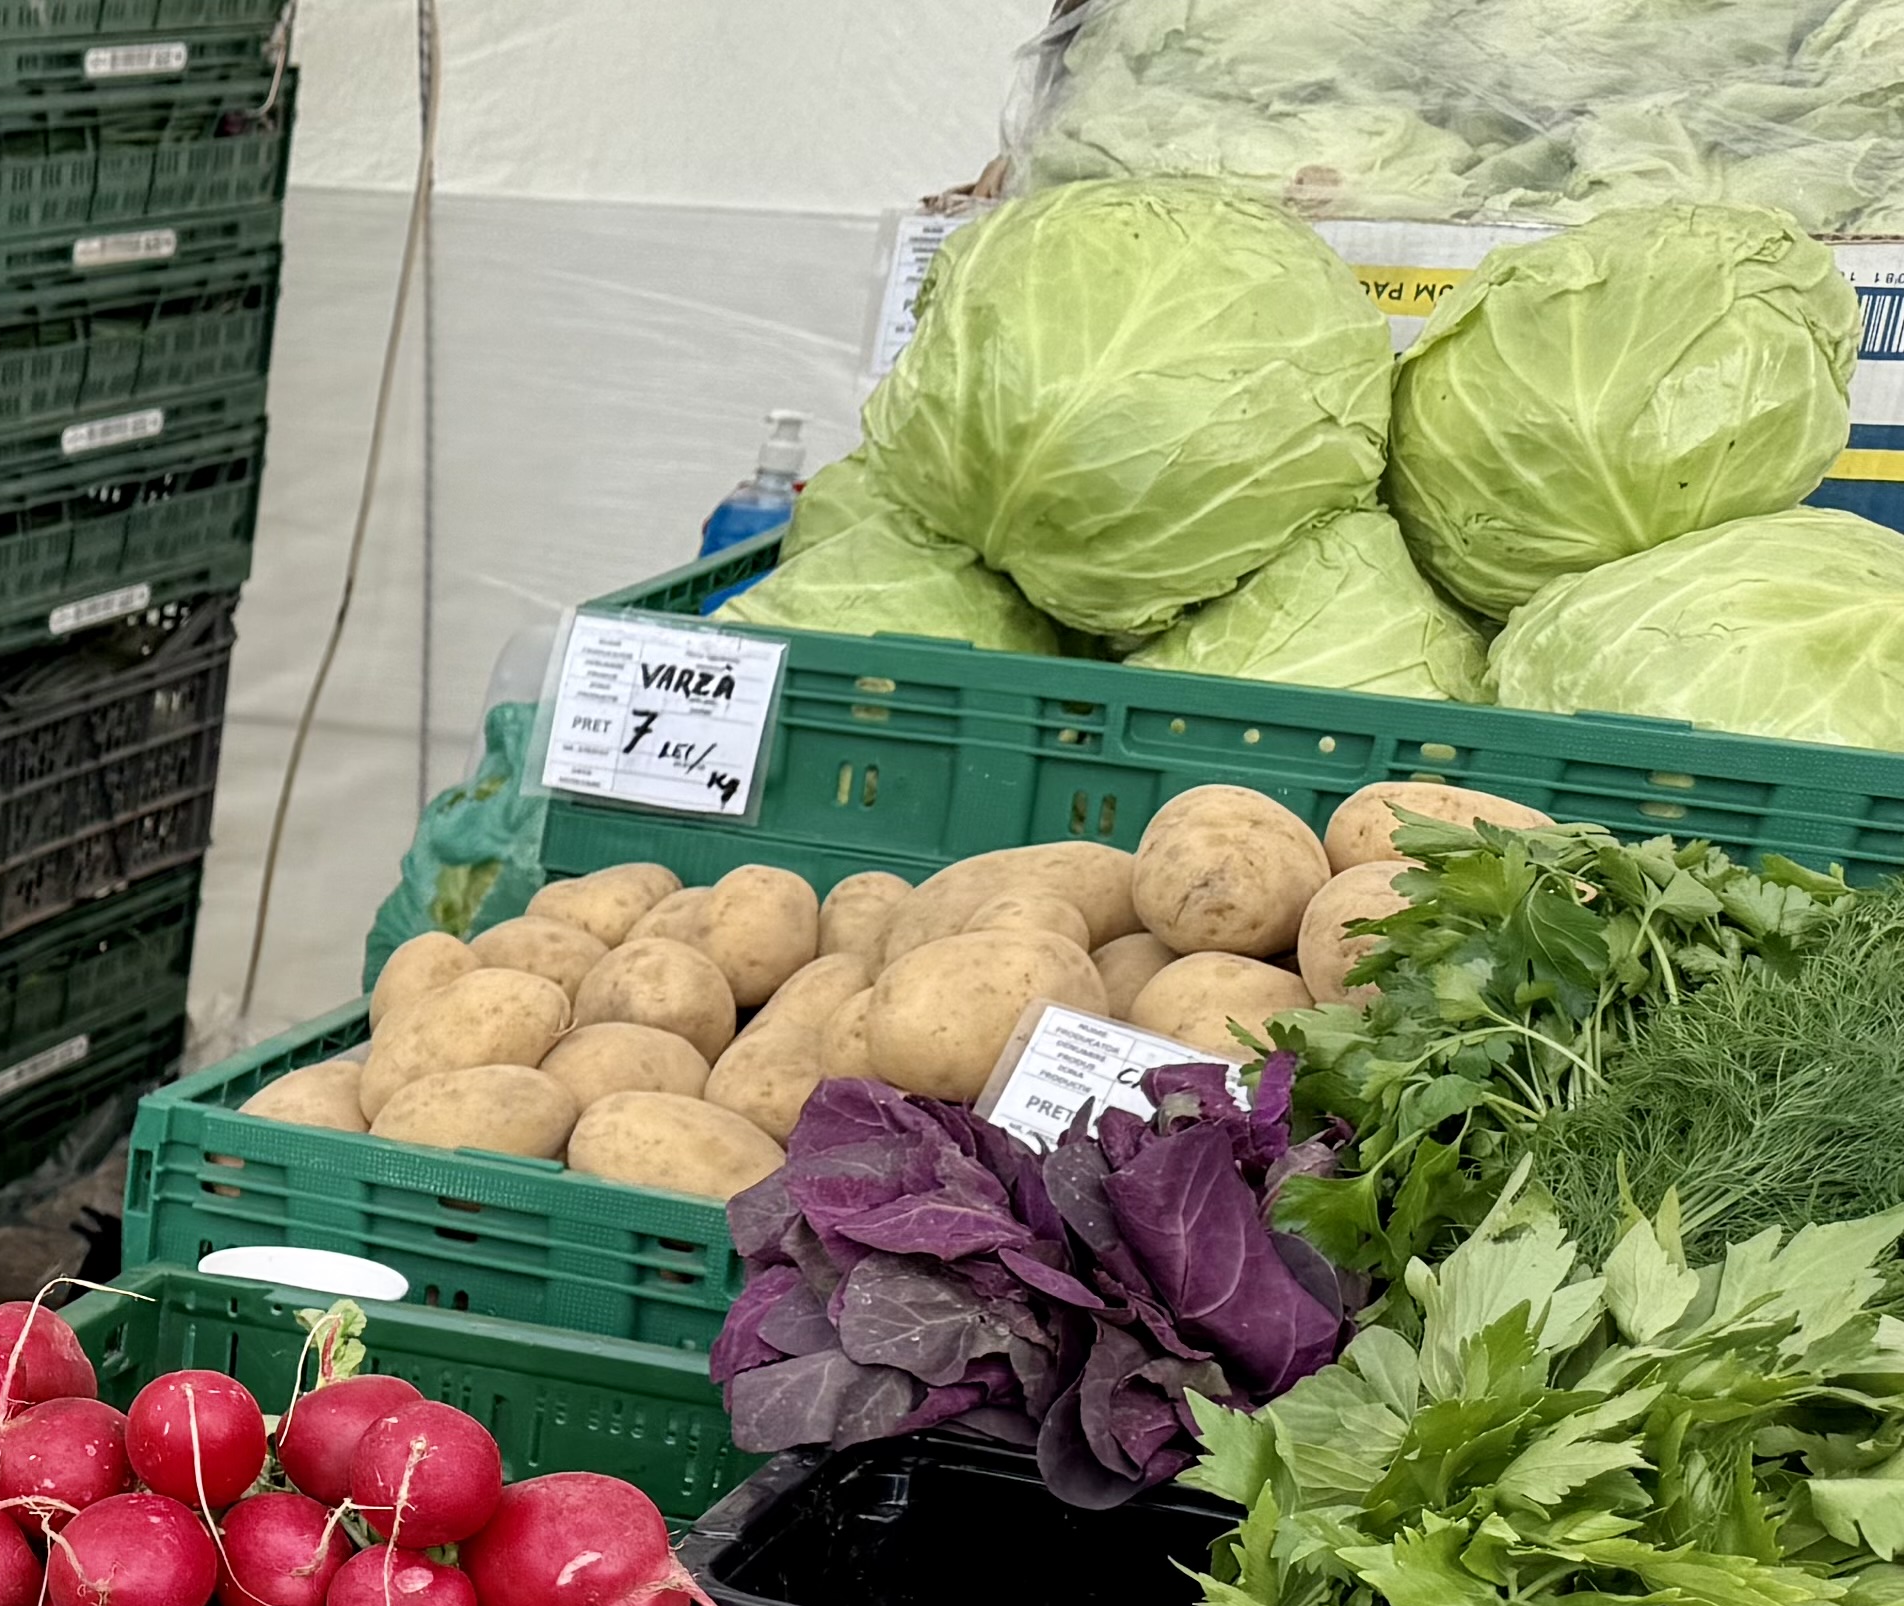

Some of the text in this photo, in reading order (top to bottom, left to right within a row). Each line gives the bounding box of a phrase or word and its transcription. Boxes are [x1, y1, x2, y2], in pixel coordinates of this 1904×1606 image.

[572, 715, 612, 733] PRET
[623, 709, 658, 754] 7
[1026, 1094, 1076, 1124] PRET
